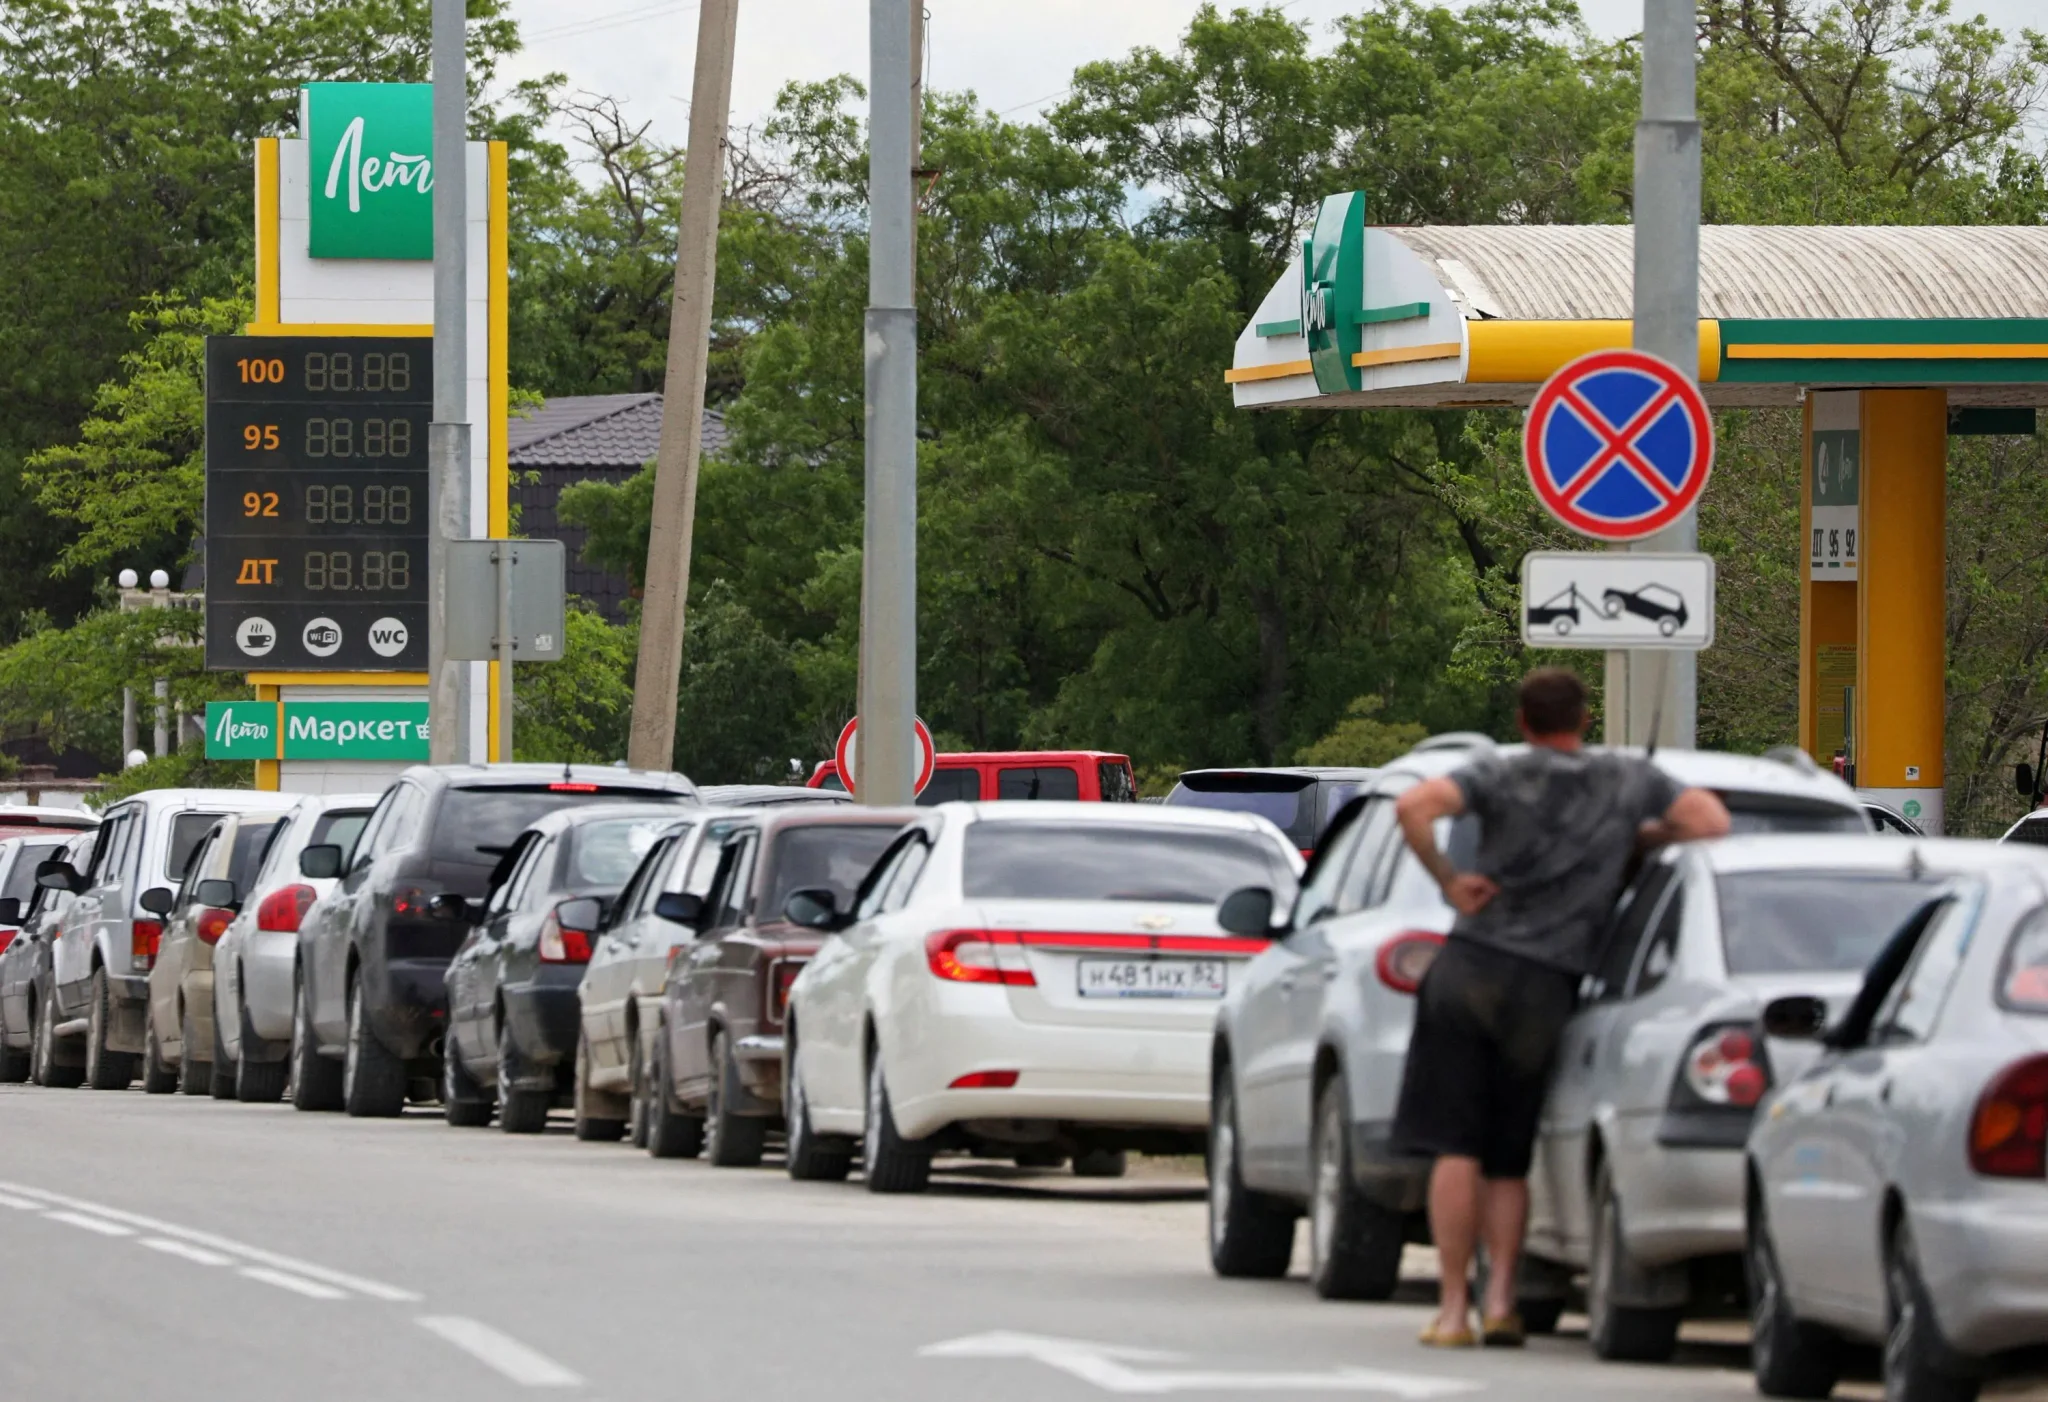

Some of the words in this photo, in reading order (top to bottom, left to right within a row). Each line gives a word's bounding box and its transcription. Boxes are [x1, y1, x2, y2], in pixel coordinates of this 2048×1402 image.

[324, 117, 433, 213] Лет
[237, 359, 284, 384] 100
[243, 425, 280, 451] 95
[243, 492, 280, 517] 92
[1829, 529, 1839, 557] 95
[1845, 529, 1856, 557] 92
[236, 559, 278, 585] ДТ
[372, 630, 405, 644] WC
[215, 708, 268, 747] Лето
[289, 716, 411, 745] Маркет
